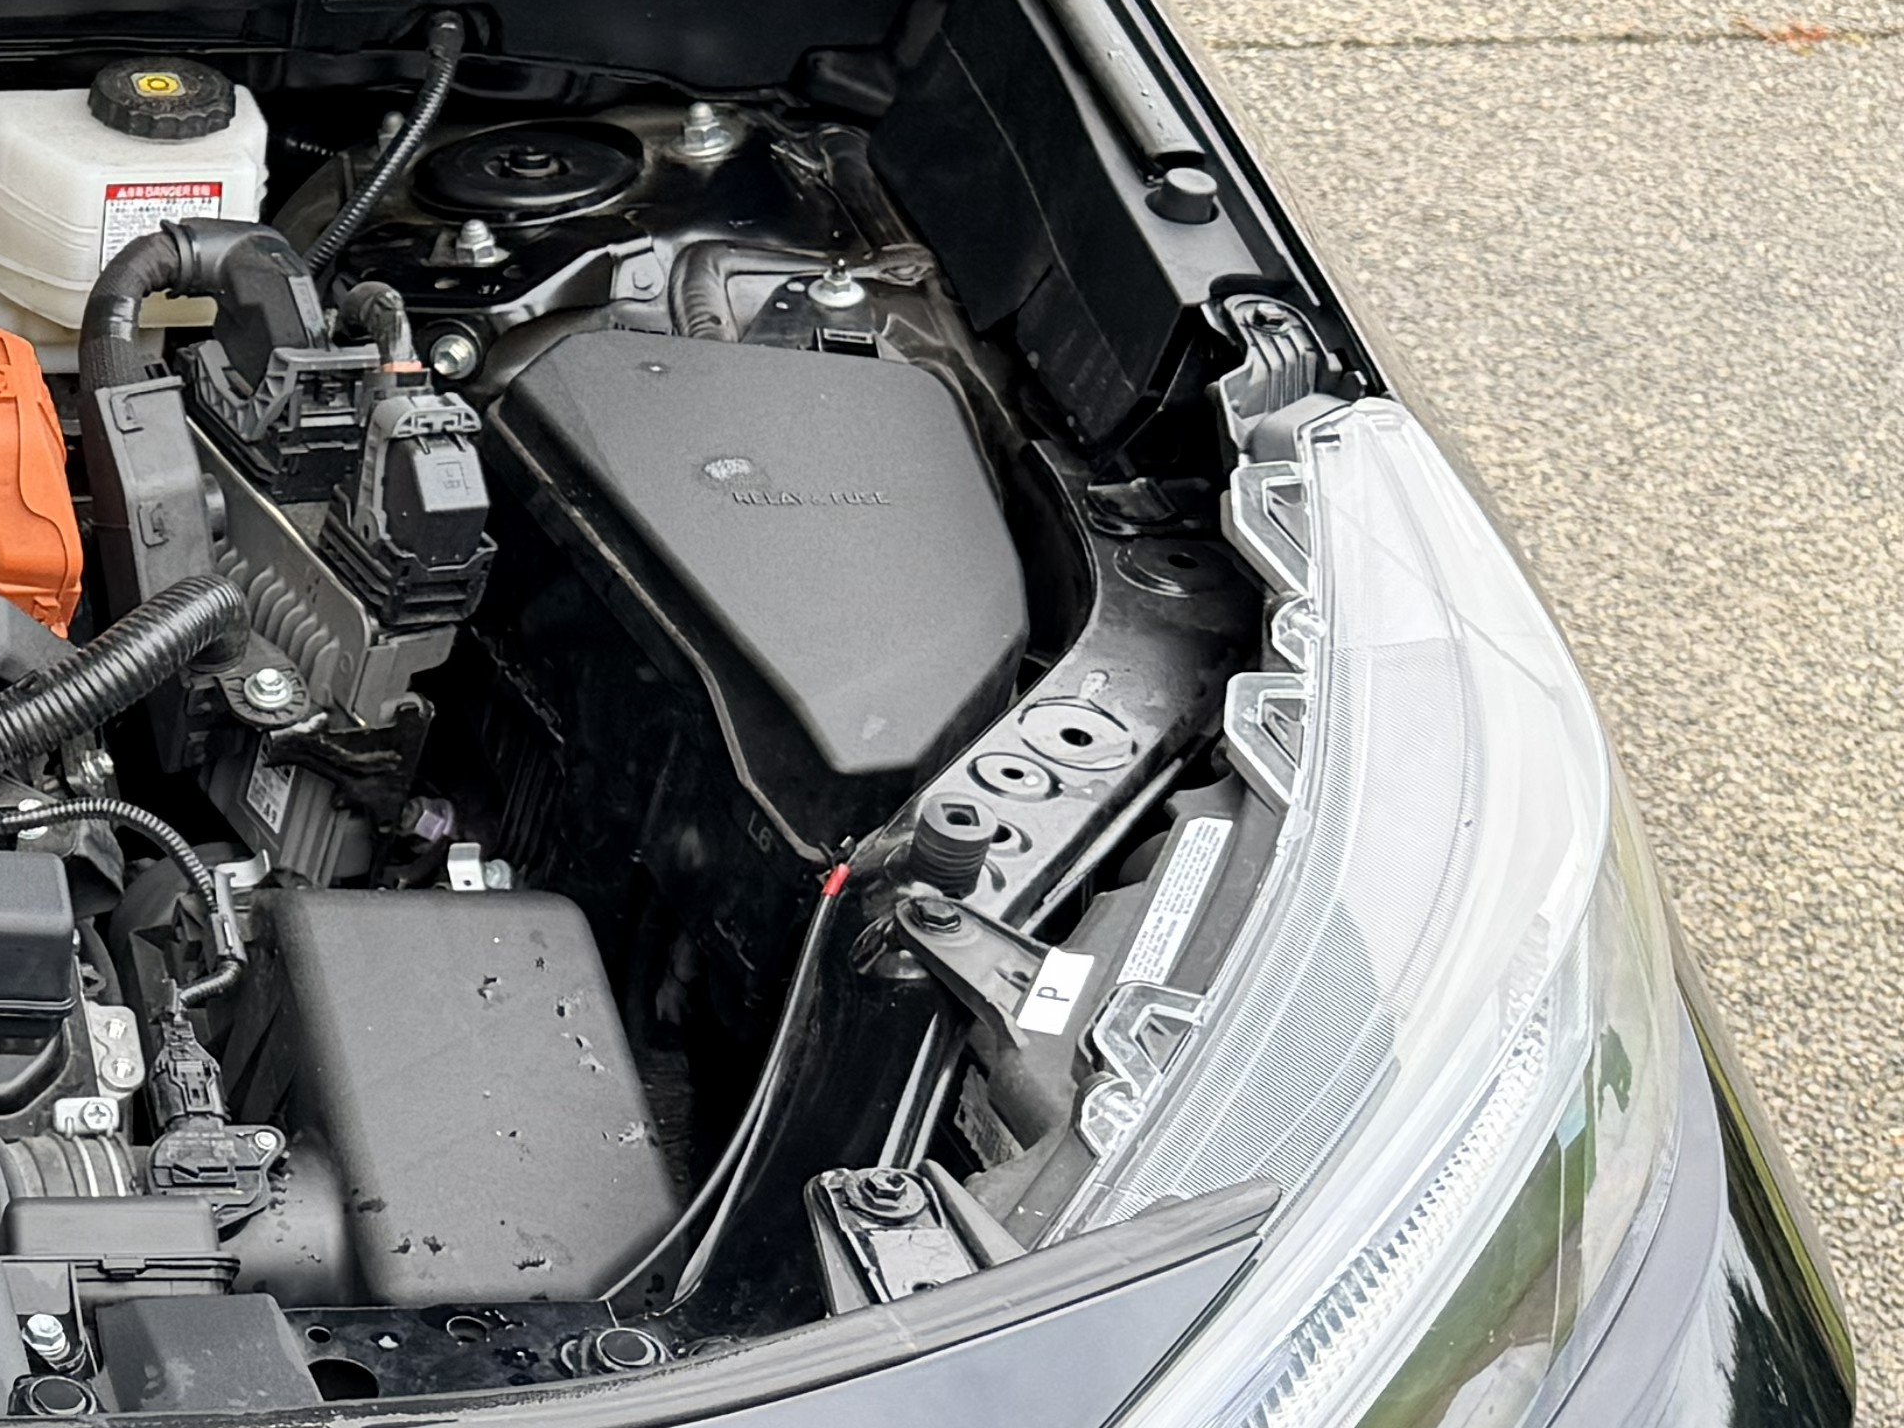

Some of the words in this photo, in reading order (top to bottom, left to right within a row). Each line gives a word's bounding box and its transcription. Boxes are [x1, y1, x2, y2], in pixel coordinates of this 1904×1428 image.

[731, 491, 804, 507] RELAY
[830, 491, 892, 507] FUSE
[1036, 986, 1070, 1002] P
